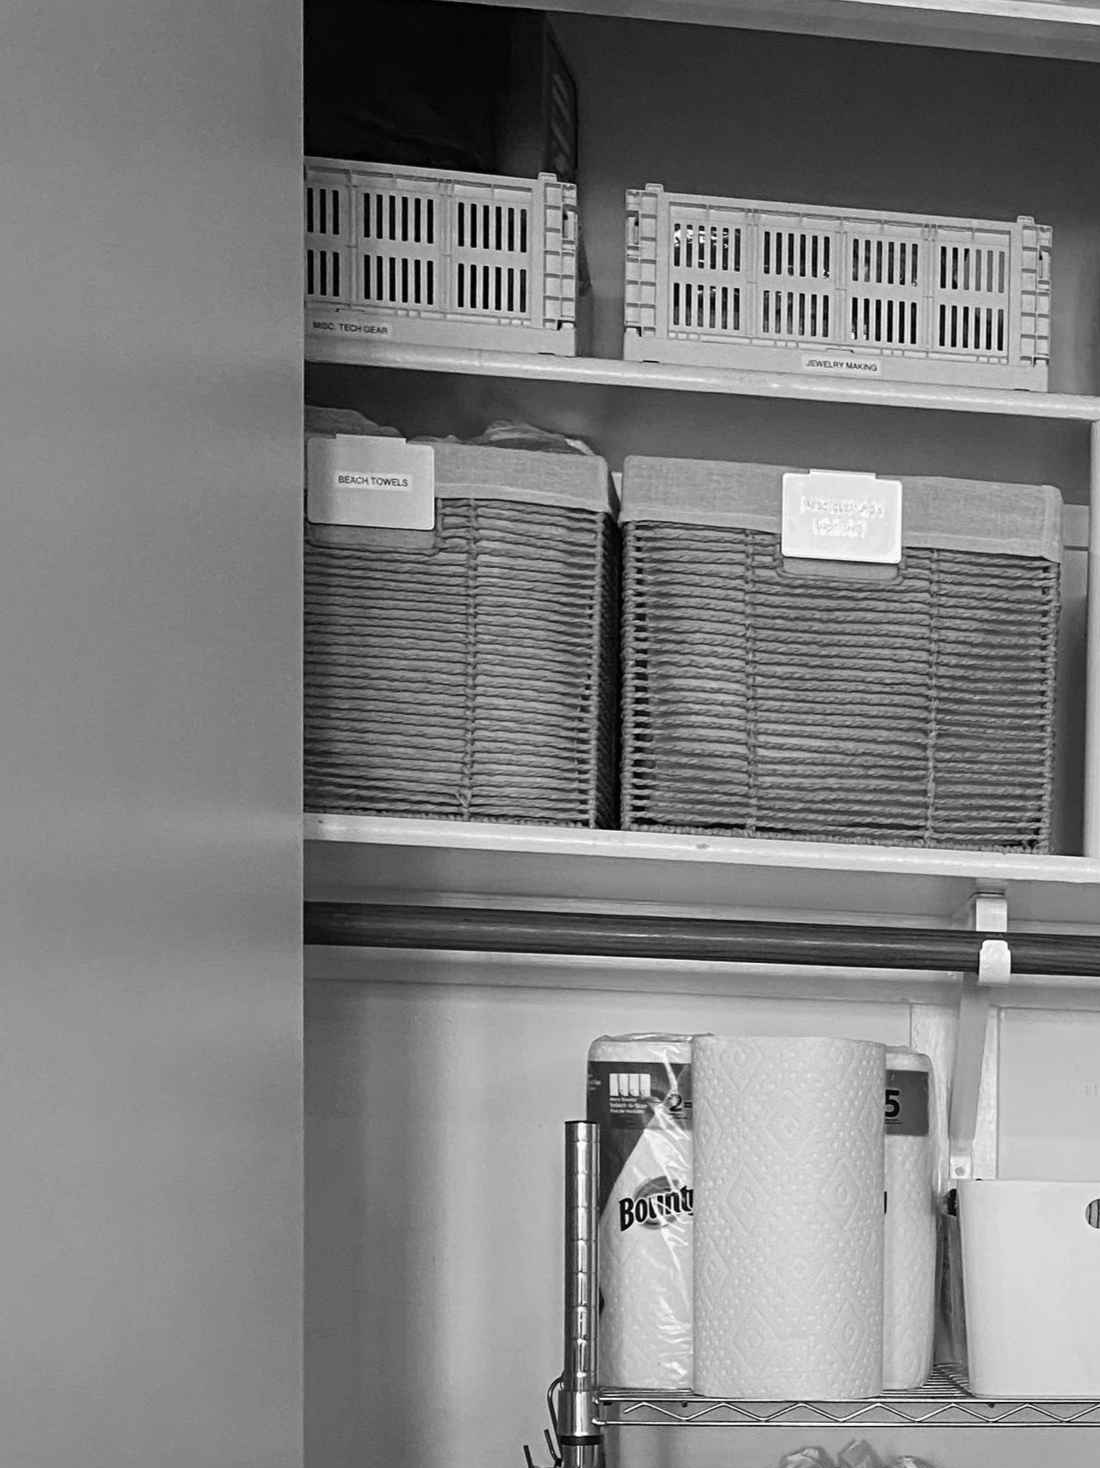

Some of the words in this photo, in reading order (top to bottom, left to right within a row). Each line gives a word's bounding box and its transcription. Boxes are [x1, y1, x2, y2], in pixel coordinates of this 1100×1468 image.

[338, 323, 361, 333] TECH
[362, 325, 388, 335] GEAR
[806, 359, 844, 369] JEWELRY
[845, 362, 877, 372] MAKING
[338, 475, 369, 486] BEACH
[370, 477, 408, 487] TOWELS
[884, 1089, 900, 1119] 5
[618, 1185, 694, 1232] Bount
